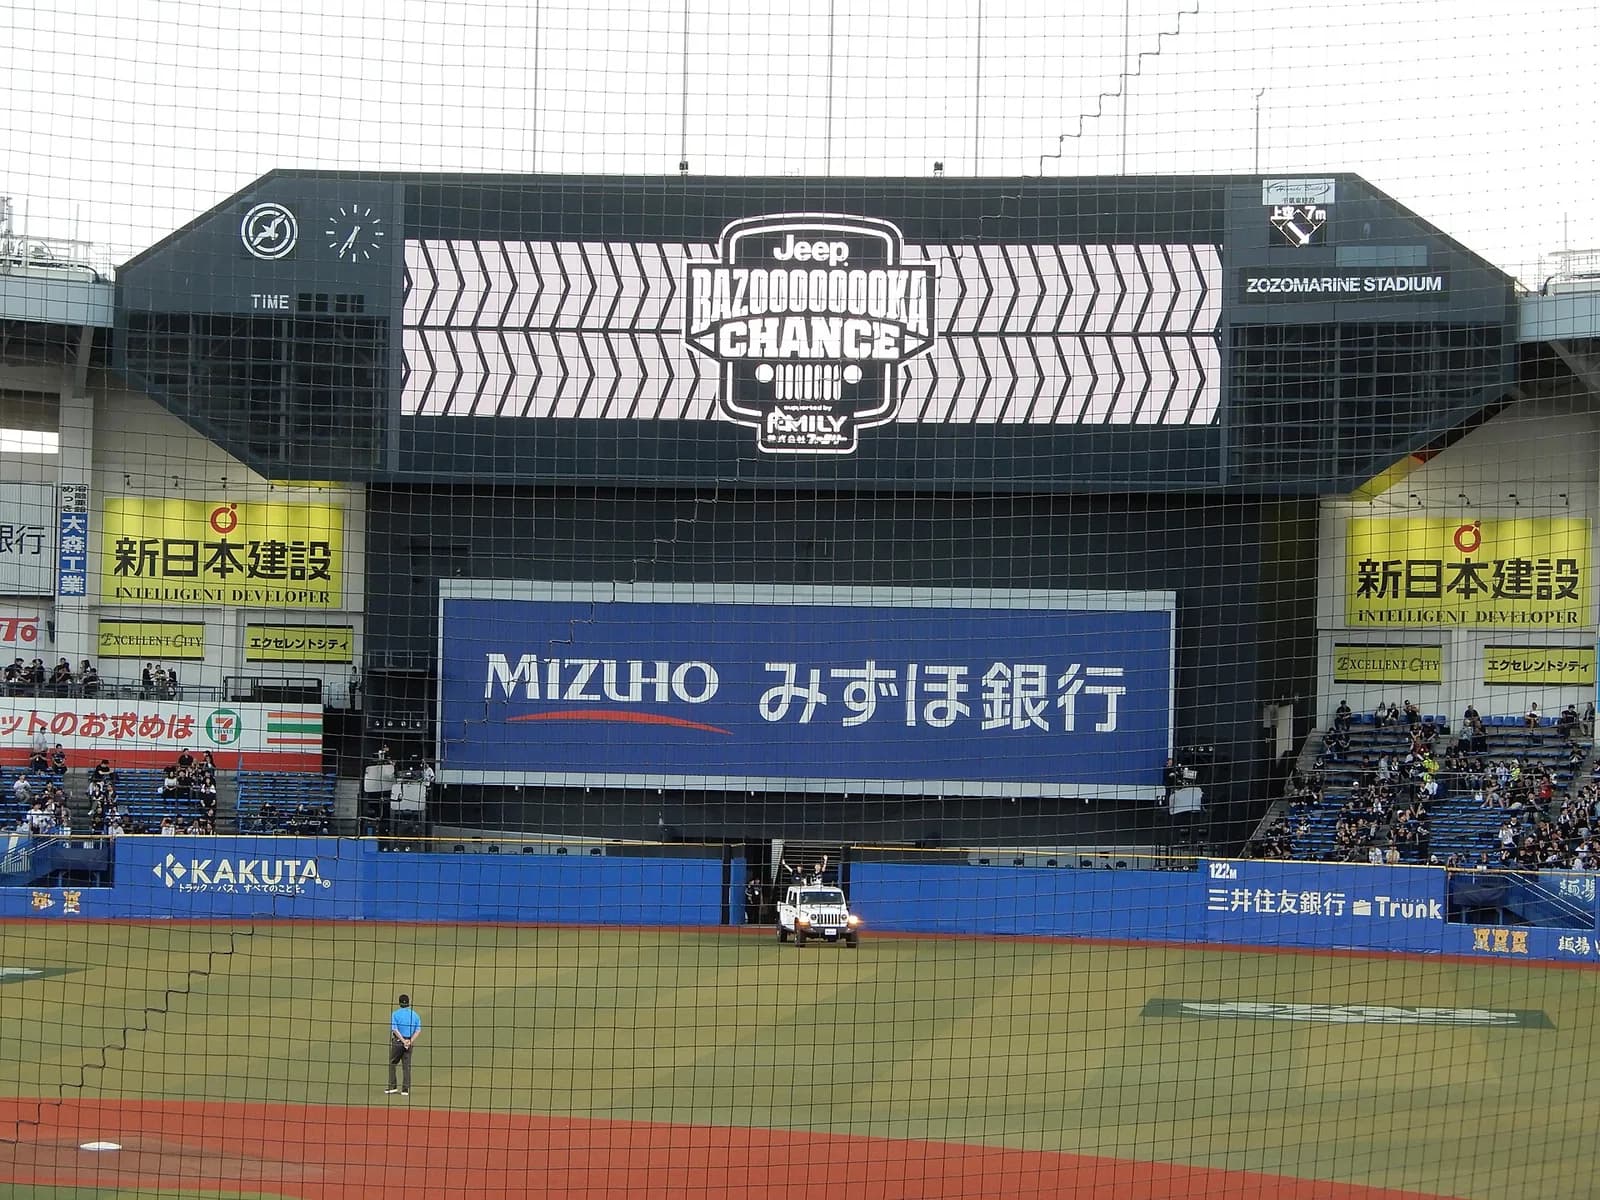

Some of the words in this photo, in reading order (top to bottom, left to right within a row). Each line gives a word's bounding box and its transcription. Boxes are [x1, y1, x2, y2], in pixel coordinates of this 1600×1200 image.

[1304, 206, 1326, 220] 7m
[773, 235, 849, 266] Jeep
[1246, 277, 1360, 293] ZOZOMARINE
[1363, 276, 1442, 291] STADIUM
[251, 294, 290, 309] TIME
[691, 268, 929, 336] BAZOOOOOOOKA
[719, 316, 900, 358] CHANCE
[61, 515, 85, 594] 大森工業
[114, 537, 331, 581] 新日本建設
[1357, 558, 1579, 600] 新日本建設
[115, 586, 225, 602] INTELLIGENT
[232, 588, 330, 604] DEVELOPER
[1358, 609, 1469, 623] INTELLIGENT
[1477, 610, 1578, 624] DEVELOPER
[250, 638, 349, 651] エクセレントシティ
[485, 653, 720, 704] MIZUHO
[1487, 659, 1589, 673] エクセレントシティ
[759, 660, 1126, 732] みずほ銀行
[1, 709, 194, 740] ットのお求めは
[1208, 888, 1346, 916] 三井住友銀行
[1375, 896, 1443, 919] Trunk
